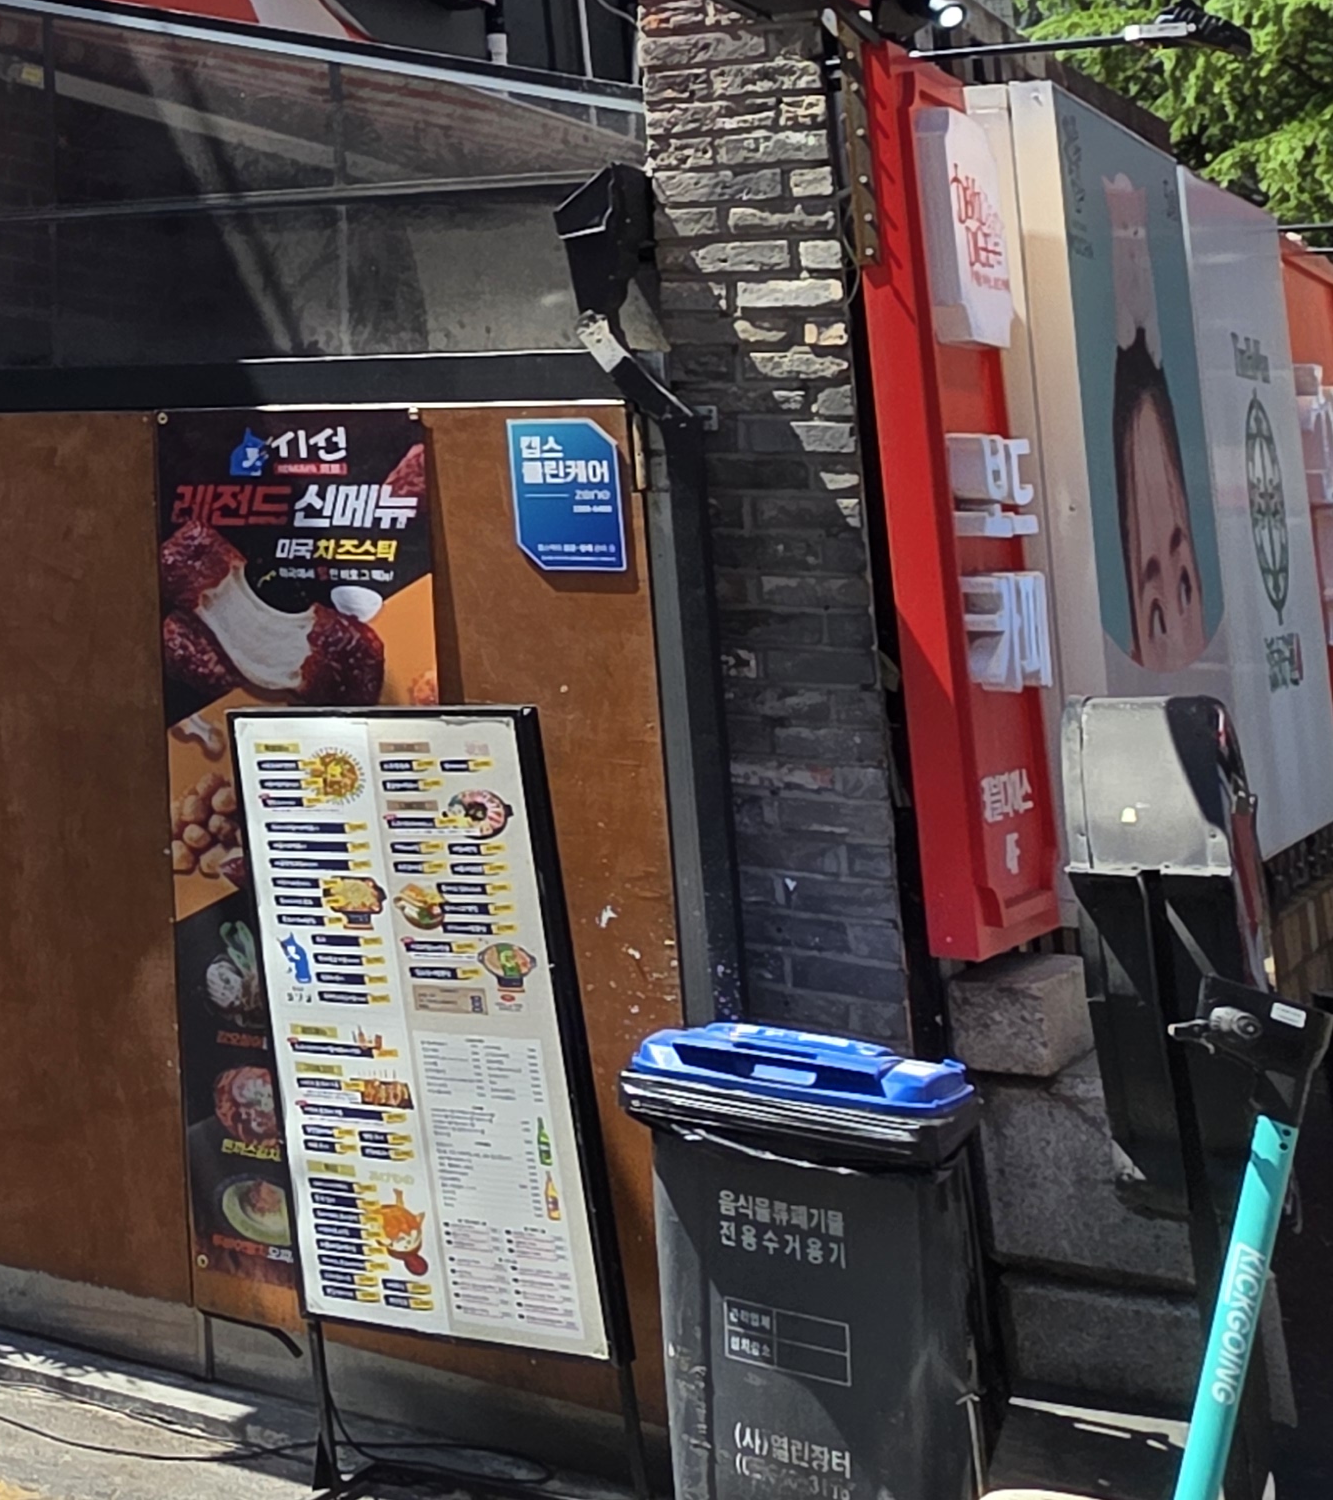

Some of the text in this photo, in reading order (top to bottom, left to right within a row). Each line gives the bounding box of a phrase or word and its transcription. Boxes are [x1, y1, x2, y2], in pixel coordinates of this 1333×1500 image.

[170, 484, 418, 529] 레전드 신메뉴
[275, 538, 397, 562] 미국 치즈스틱
[719, 1190, 844, 1237] 음식물류폐기물
[720, 1221, 846, 1270] 전용수거용기
[1211, 1242, 1266, 1406] KICKGOING
